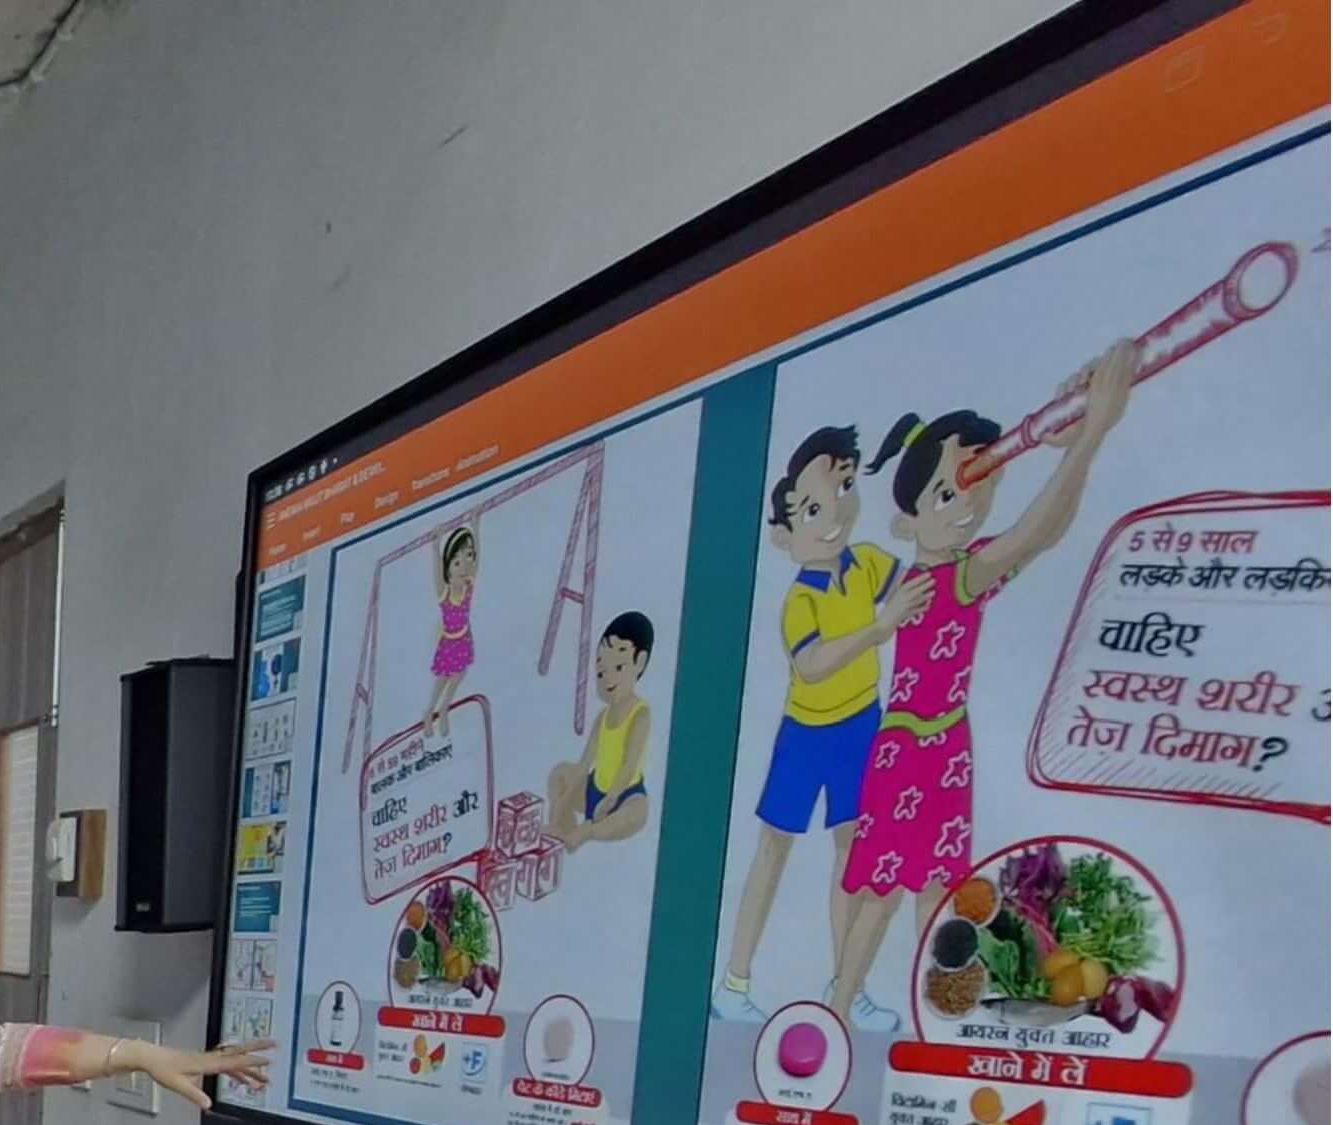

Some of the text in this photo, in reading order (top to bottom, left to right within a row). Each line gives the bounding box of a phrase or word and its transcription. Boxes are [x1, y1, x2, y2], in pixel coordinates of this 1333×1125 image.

[1129, 521, 1259, 554] 5 से 9 साल
[1119, 556, 1331, 597] लड़के और लड़कि
[1083, 669, 1302, 717] स्वस्थ शरीर
[414, 803, 448, 838] शरीर
[452, 789, 480, 818] और
[968, 1051, 1088, 1086] खाने में लें
